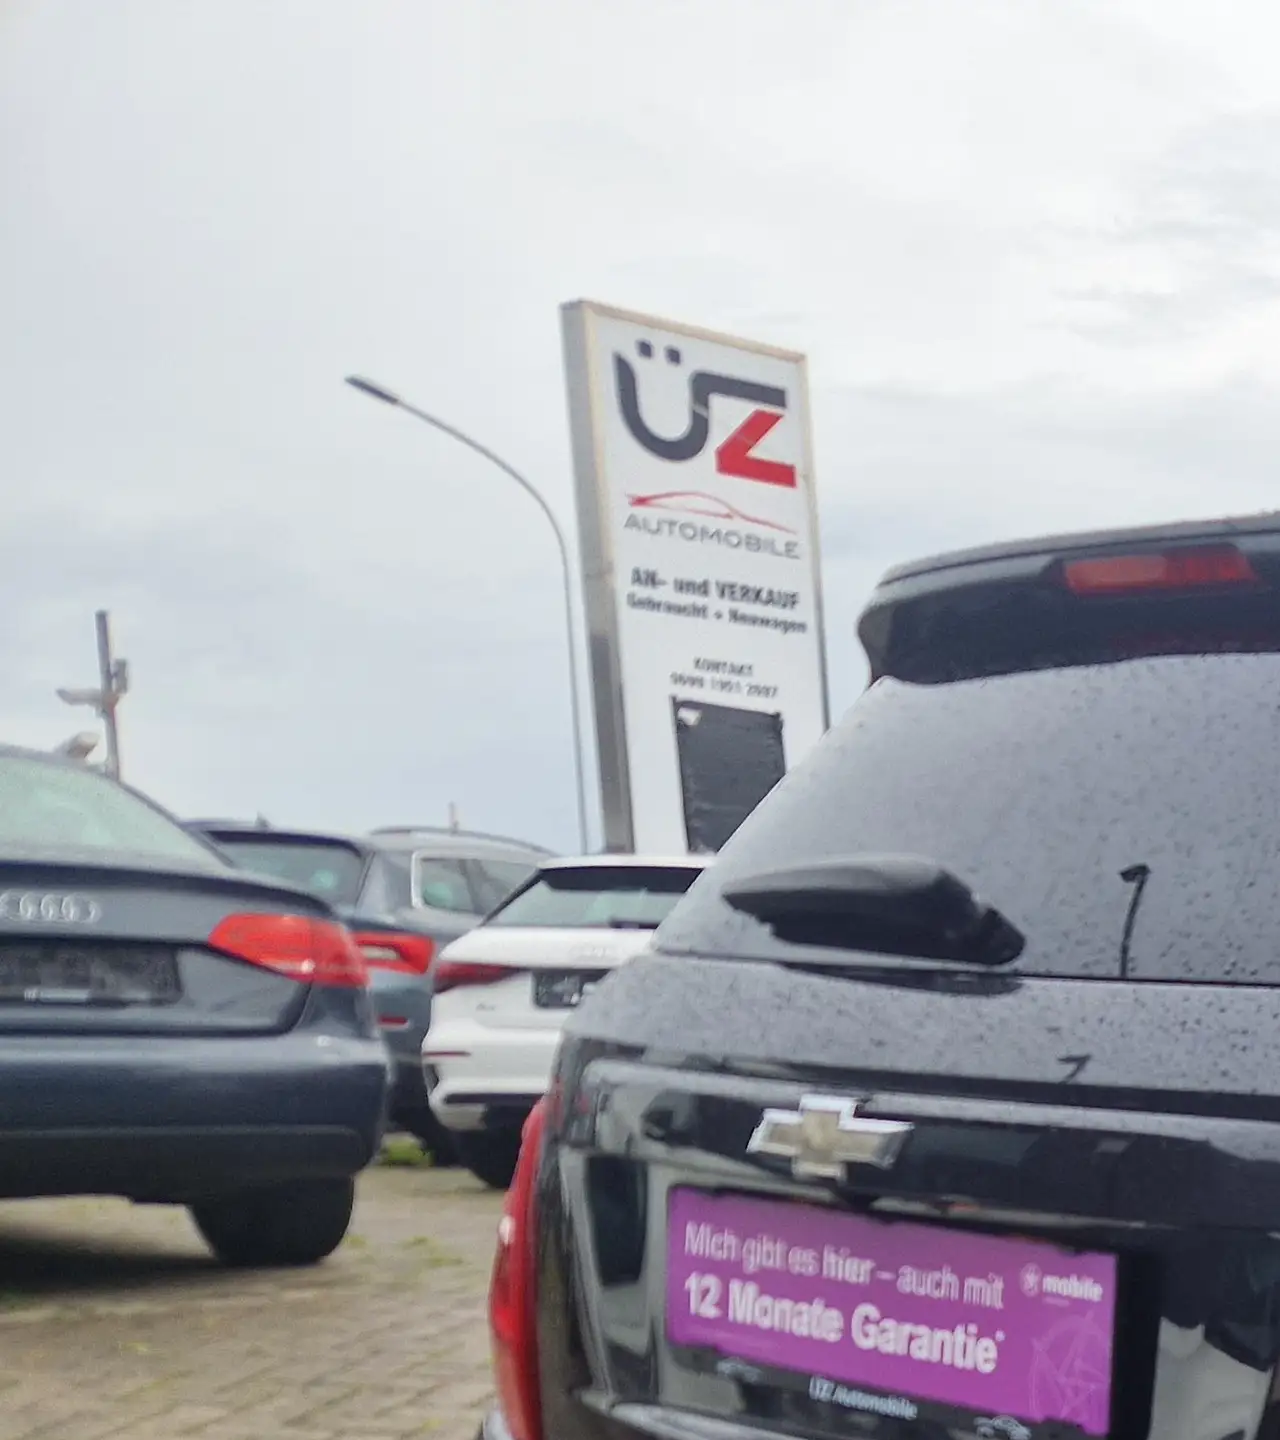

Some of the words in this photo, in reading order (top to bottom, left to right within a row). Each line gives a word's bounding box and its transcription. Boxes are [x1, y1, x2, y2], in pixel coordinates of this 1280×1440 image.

[624, 513, 800, 559] AUTOMOBILE
[674, 577, 709, 598] und
[715, 579, 801, 610] VERKAUF
[684, 1221, 740, 1262] Mich
[742, 1234, 788, 1275] gibt
[788, 1246, 820, 1276] es
[822, 1244, 875, 1285] hier
[897, 1264, 960, 1302] auch
[963, 1272, 1005, 1310] mit
[684, 1271, 723, 1319] 12
[728, 1278, 844, 1343] Monate
